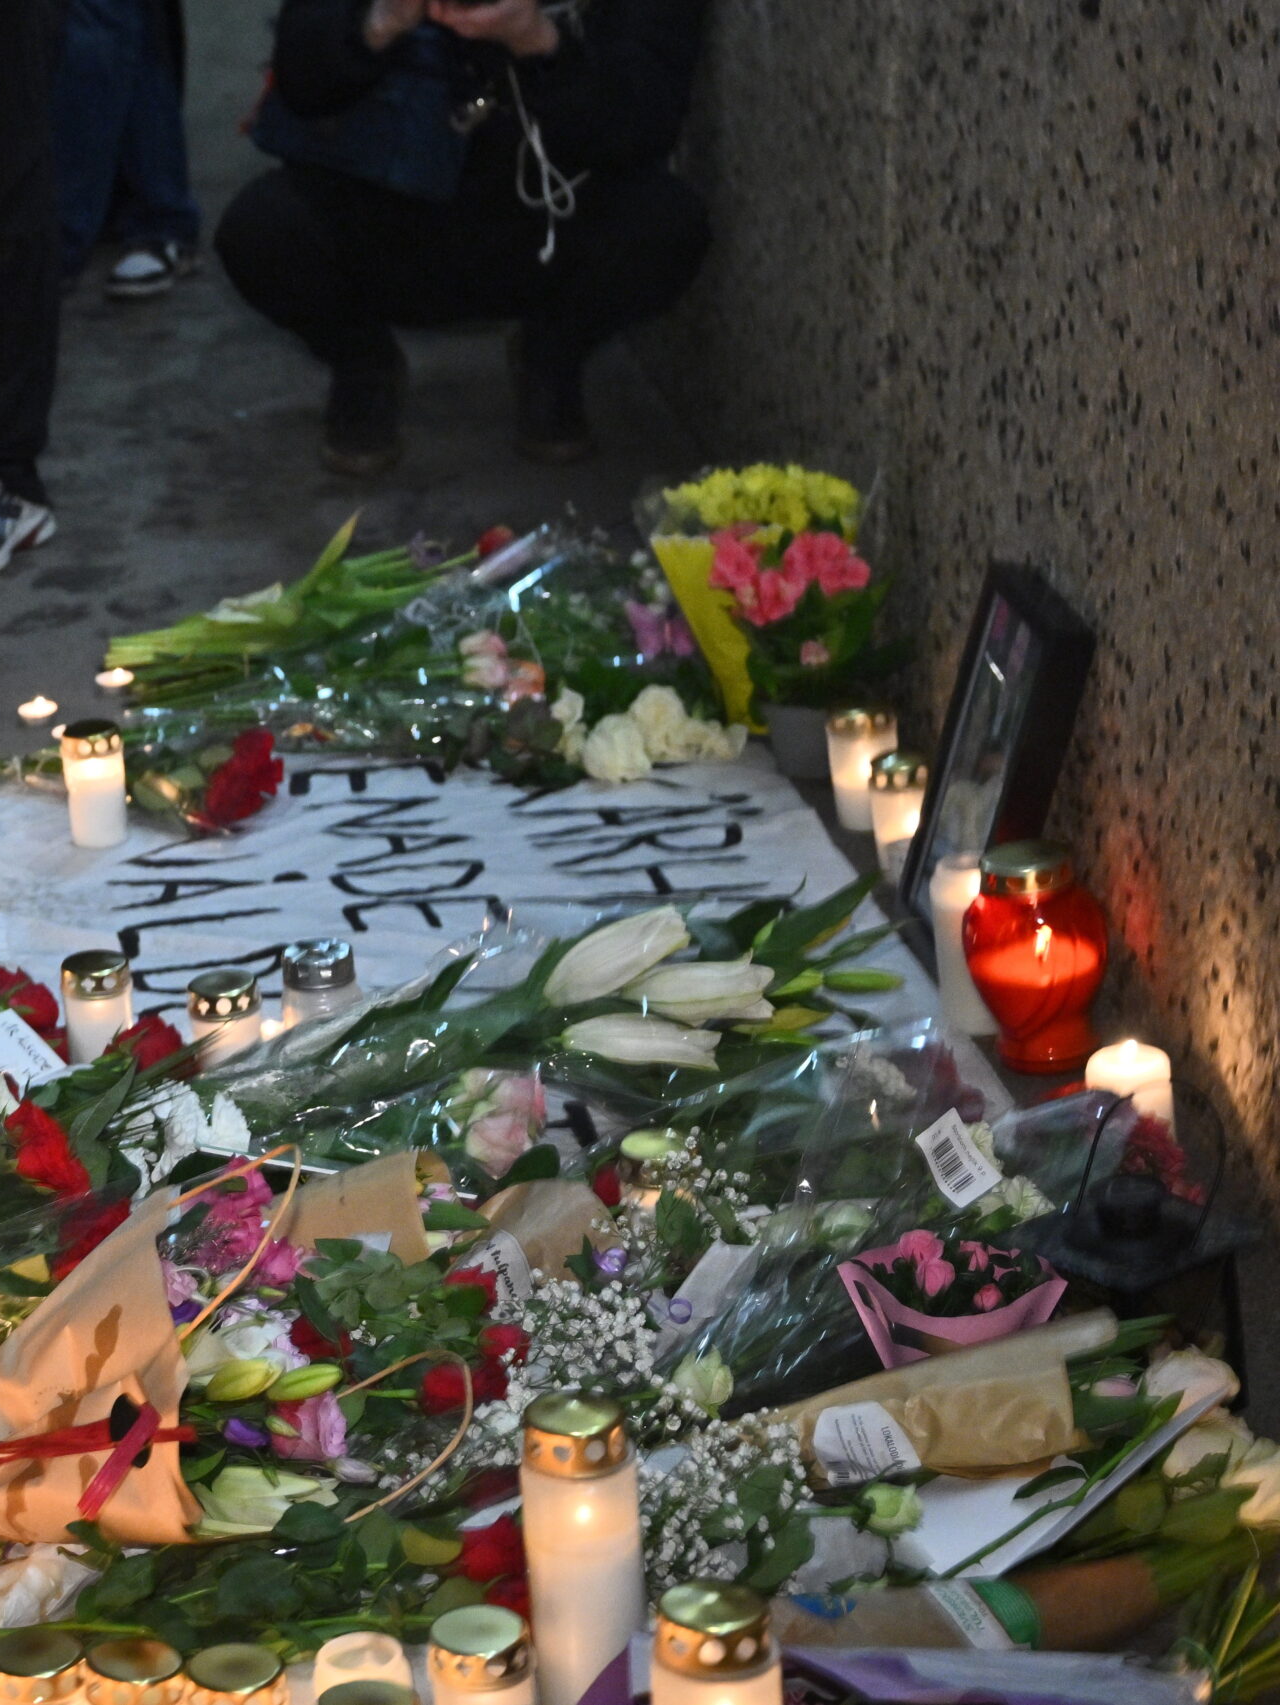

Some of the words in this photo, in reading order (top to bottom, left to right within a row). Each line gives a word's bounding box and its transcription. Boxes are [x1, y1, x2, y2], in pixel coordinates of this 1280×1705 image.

[107, 838, 308, 1018] VÅLD
[289, 760, 510, 932] ENADE
[491, 1249, 518, 1299] tulpane
